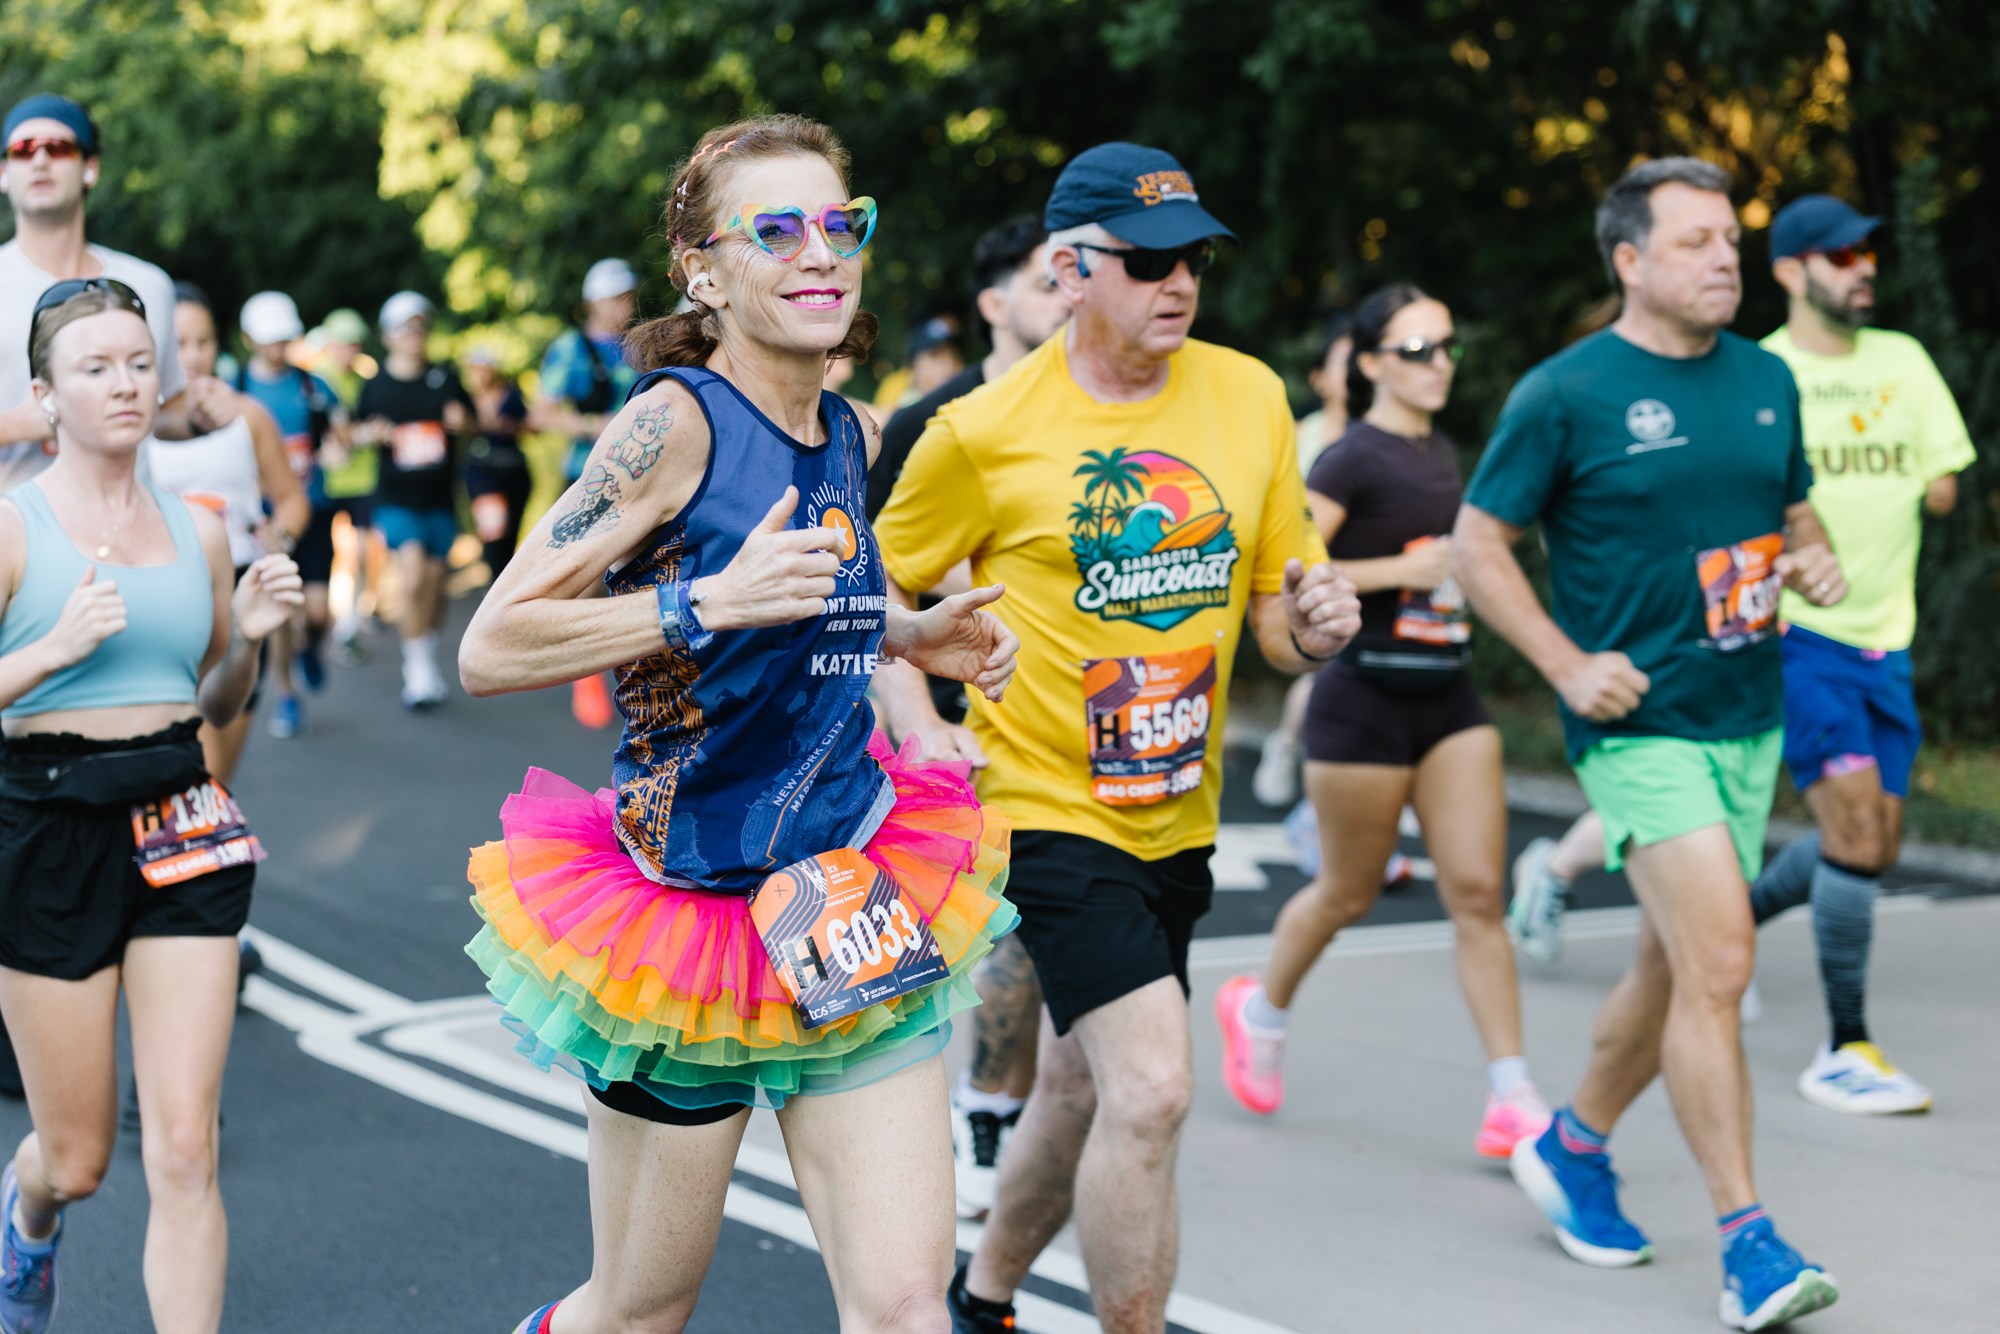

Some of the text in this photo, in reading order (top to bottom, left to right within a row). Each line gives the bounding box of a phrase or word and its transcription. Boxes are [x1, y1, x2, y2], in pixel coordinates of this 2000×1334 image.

[1806, 443, 1909, 476] UIDE
[1121, 548, 1199, 573] SARASOTA
[1078, 547, 1239, 609] Suncoast
[822, 597, 846, 615] ONT
[1104, 600, 1138, 617] HALF
[851, 619, 880, 631] YORK
[811, 654, 879, 676] KATIE
[1096, 713, 1120, 749] H
[1129, 693, 1209, 751] 5569
[773, 719, 845, 806] NEW YORK CITY
[781, 935, 829, 989] H
[826, 899, 922, 974] 6033
[808, 1006, 829, 1020] tcs
